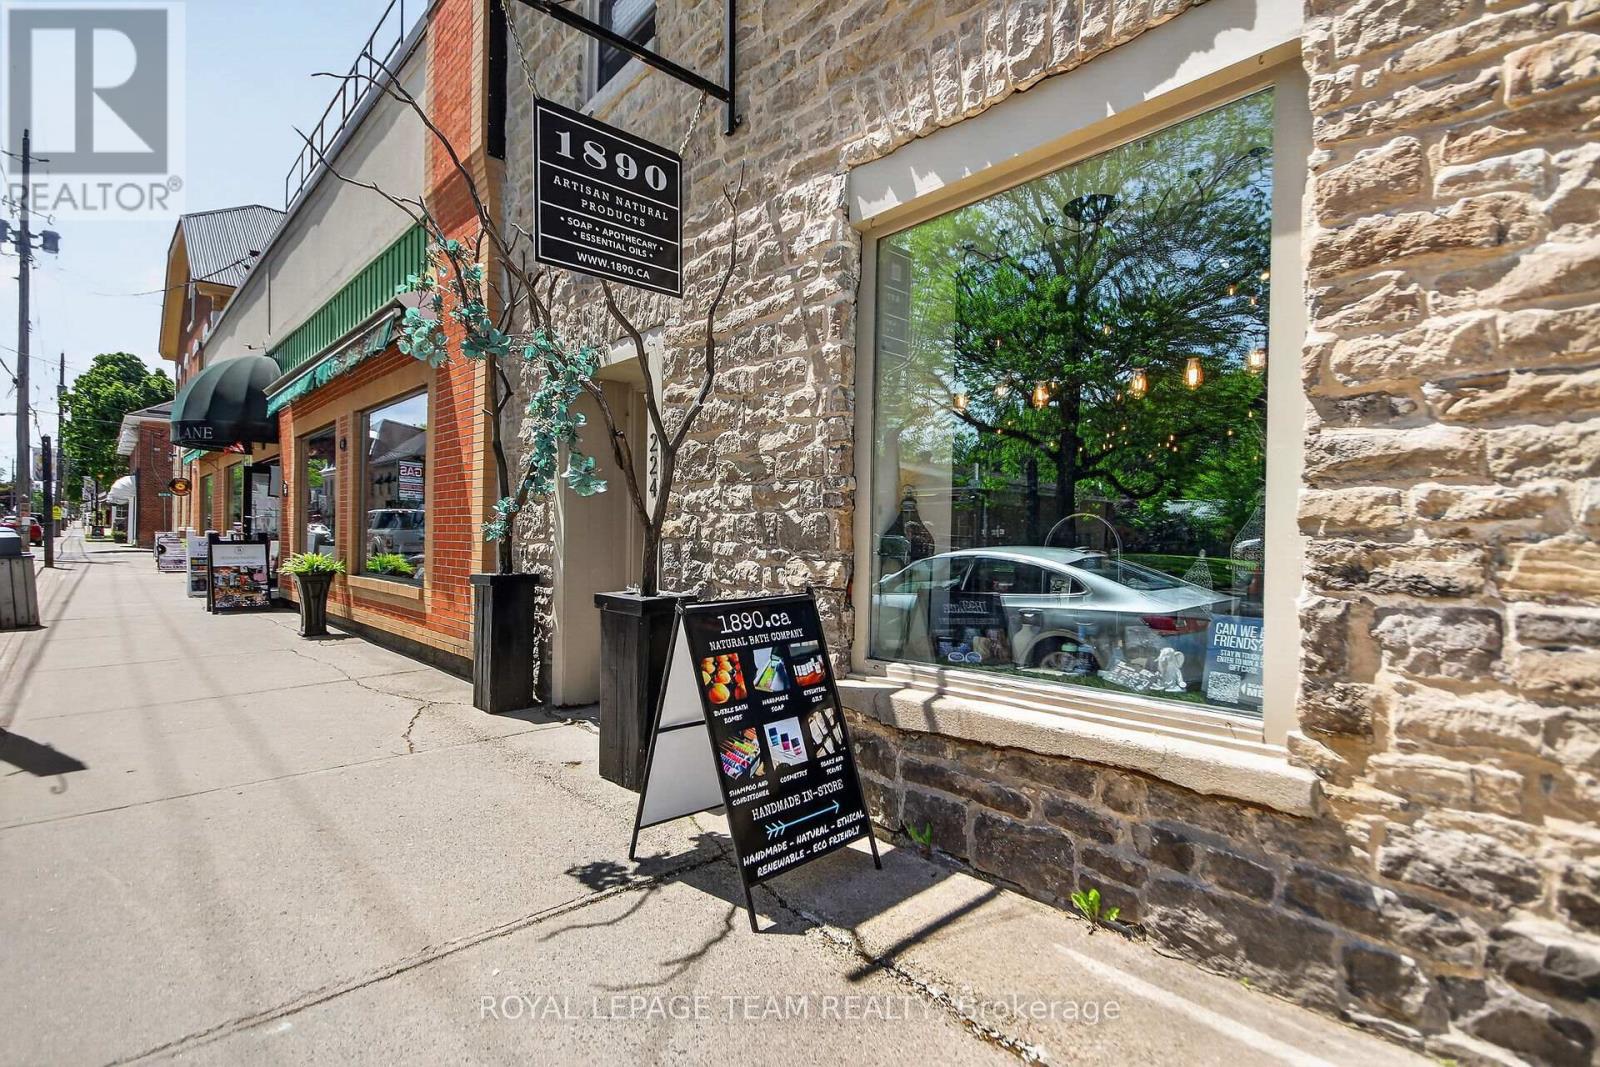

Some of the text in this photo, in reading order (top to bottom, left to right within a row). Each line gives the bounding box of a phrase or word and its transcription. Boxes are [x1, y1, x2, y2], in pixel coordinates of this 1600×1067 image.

[555, 131, 667, 191] 1890
[553, 175, 669, 221] ARTISAN NATURAL
[581, 198, 646, 227] PRODUCTS
[567, 217, 658, 250] SOAP APOTHECARY
[580, 231, 647, 258] ESSENTIAL OILS
[576, 252, 650, 279] WWW.1890.CA
[177, 424, 213, 439] LANE
[649, 433, 658, 498] 224
[717, 610, 792, 634] 1890.ca
[1215, 622, 1238, 636] CAN
[1240, 625, 1258, 638] WE
[709, 628, 804, 651] NATURAL BATH COMPANY
[1213, 634, 1264, 651] FRIENDS?
[713, 703, 749, 717] BUBBLE BATH
[762, 694, 789, 706] HANDMADE
[771, 704, 785, 713] SOAP
[729, 780, 769, 797] SHAMPOO AND
[780, 769, 808, 784] COSMETICS
[732, 789, 770, 806] CONDITIONER
[752, 779, 844, 821] HANDMADE IN-STORE
[743, 841, 788, 867] HANDMADE
[796, 824, 829, 845] NATURAL
[836, 809, 865, 828] ETHICAL
[757, 849, 805, 878] RENEWABLE
[813, 840, 827, 852] ECO
[828, 825, 860, 847] FRIENDLY
